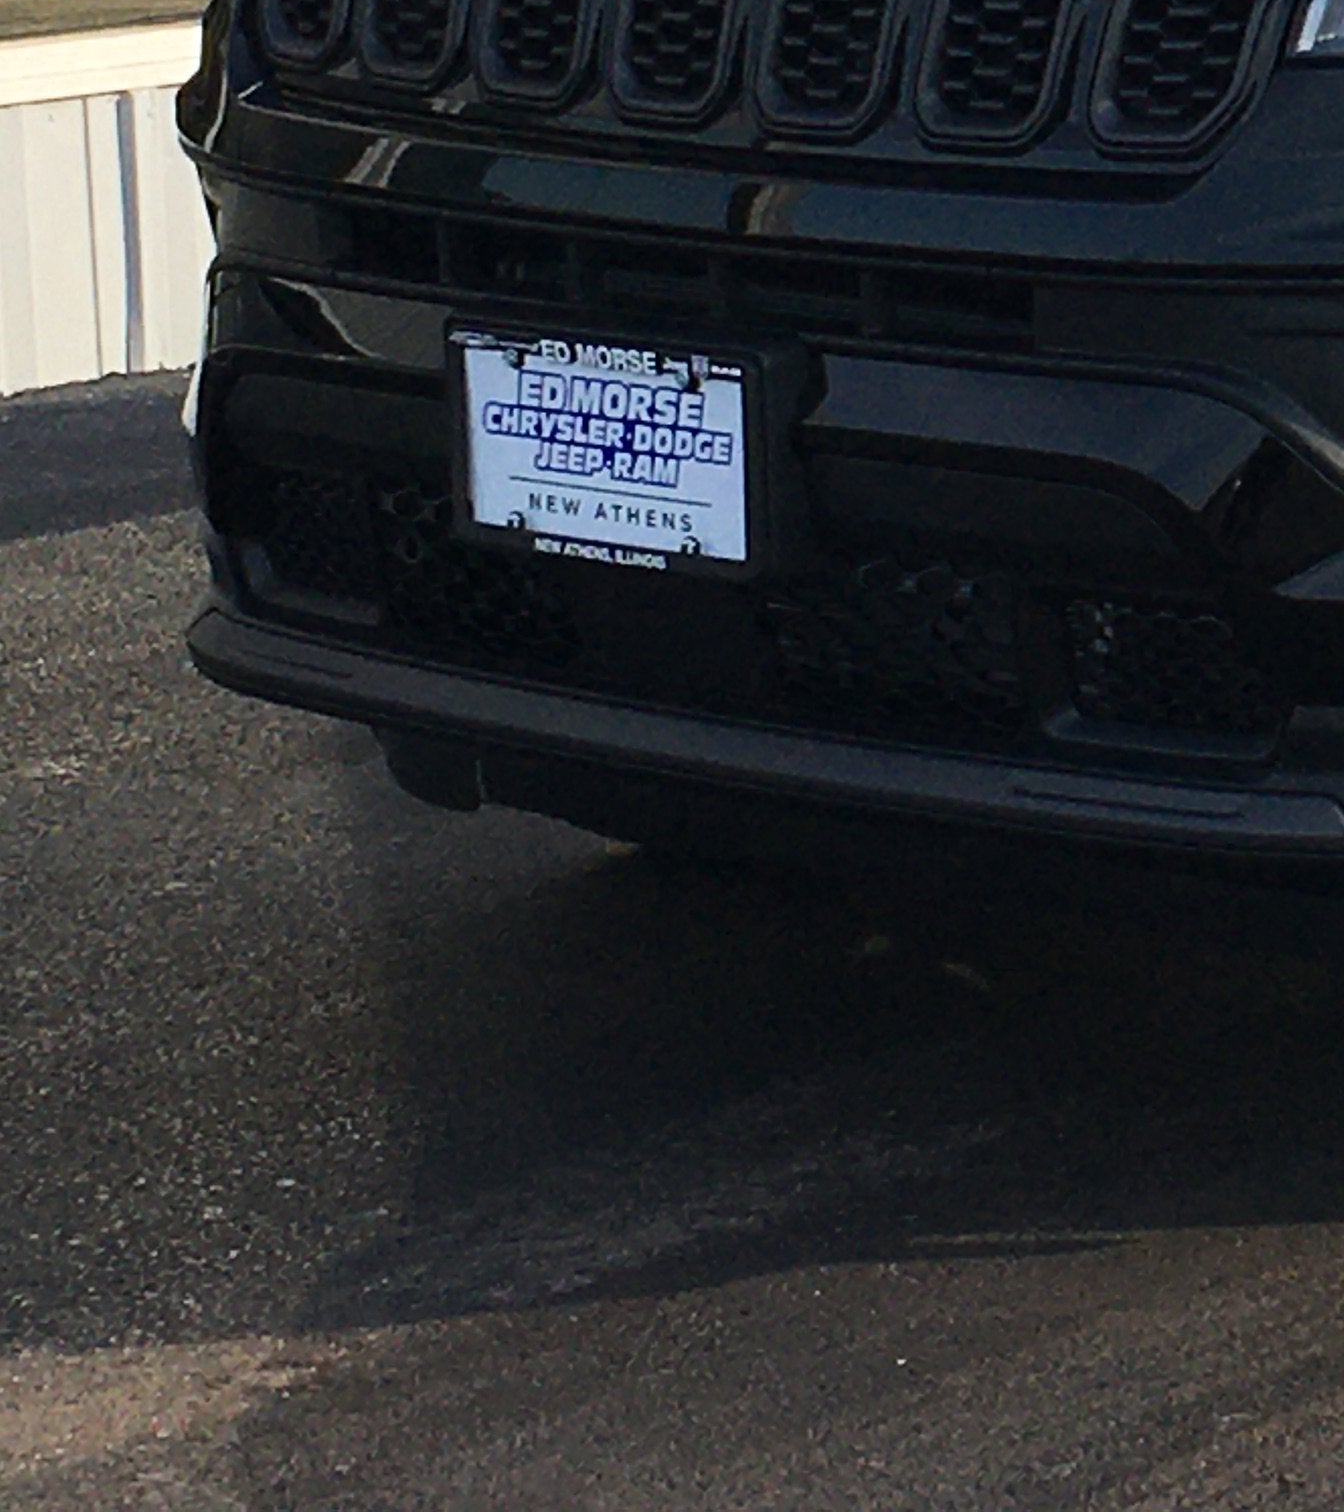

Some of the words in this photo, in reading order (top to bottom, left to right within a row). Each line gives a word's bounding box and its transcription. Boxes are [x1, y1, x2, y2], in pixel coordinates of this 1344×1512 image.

[540, 339, 571, 364] ED
[575, 344, 657, 375] MORSE
[519, 370, 567, 412] ED
[570, 376, 705, 428] MORSE
[528, 492, 580, 517] NEW
[594, 502, 693, 532] ATHENS
